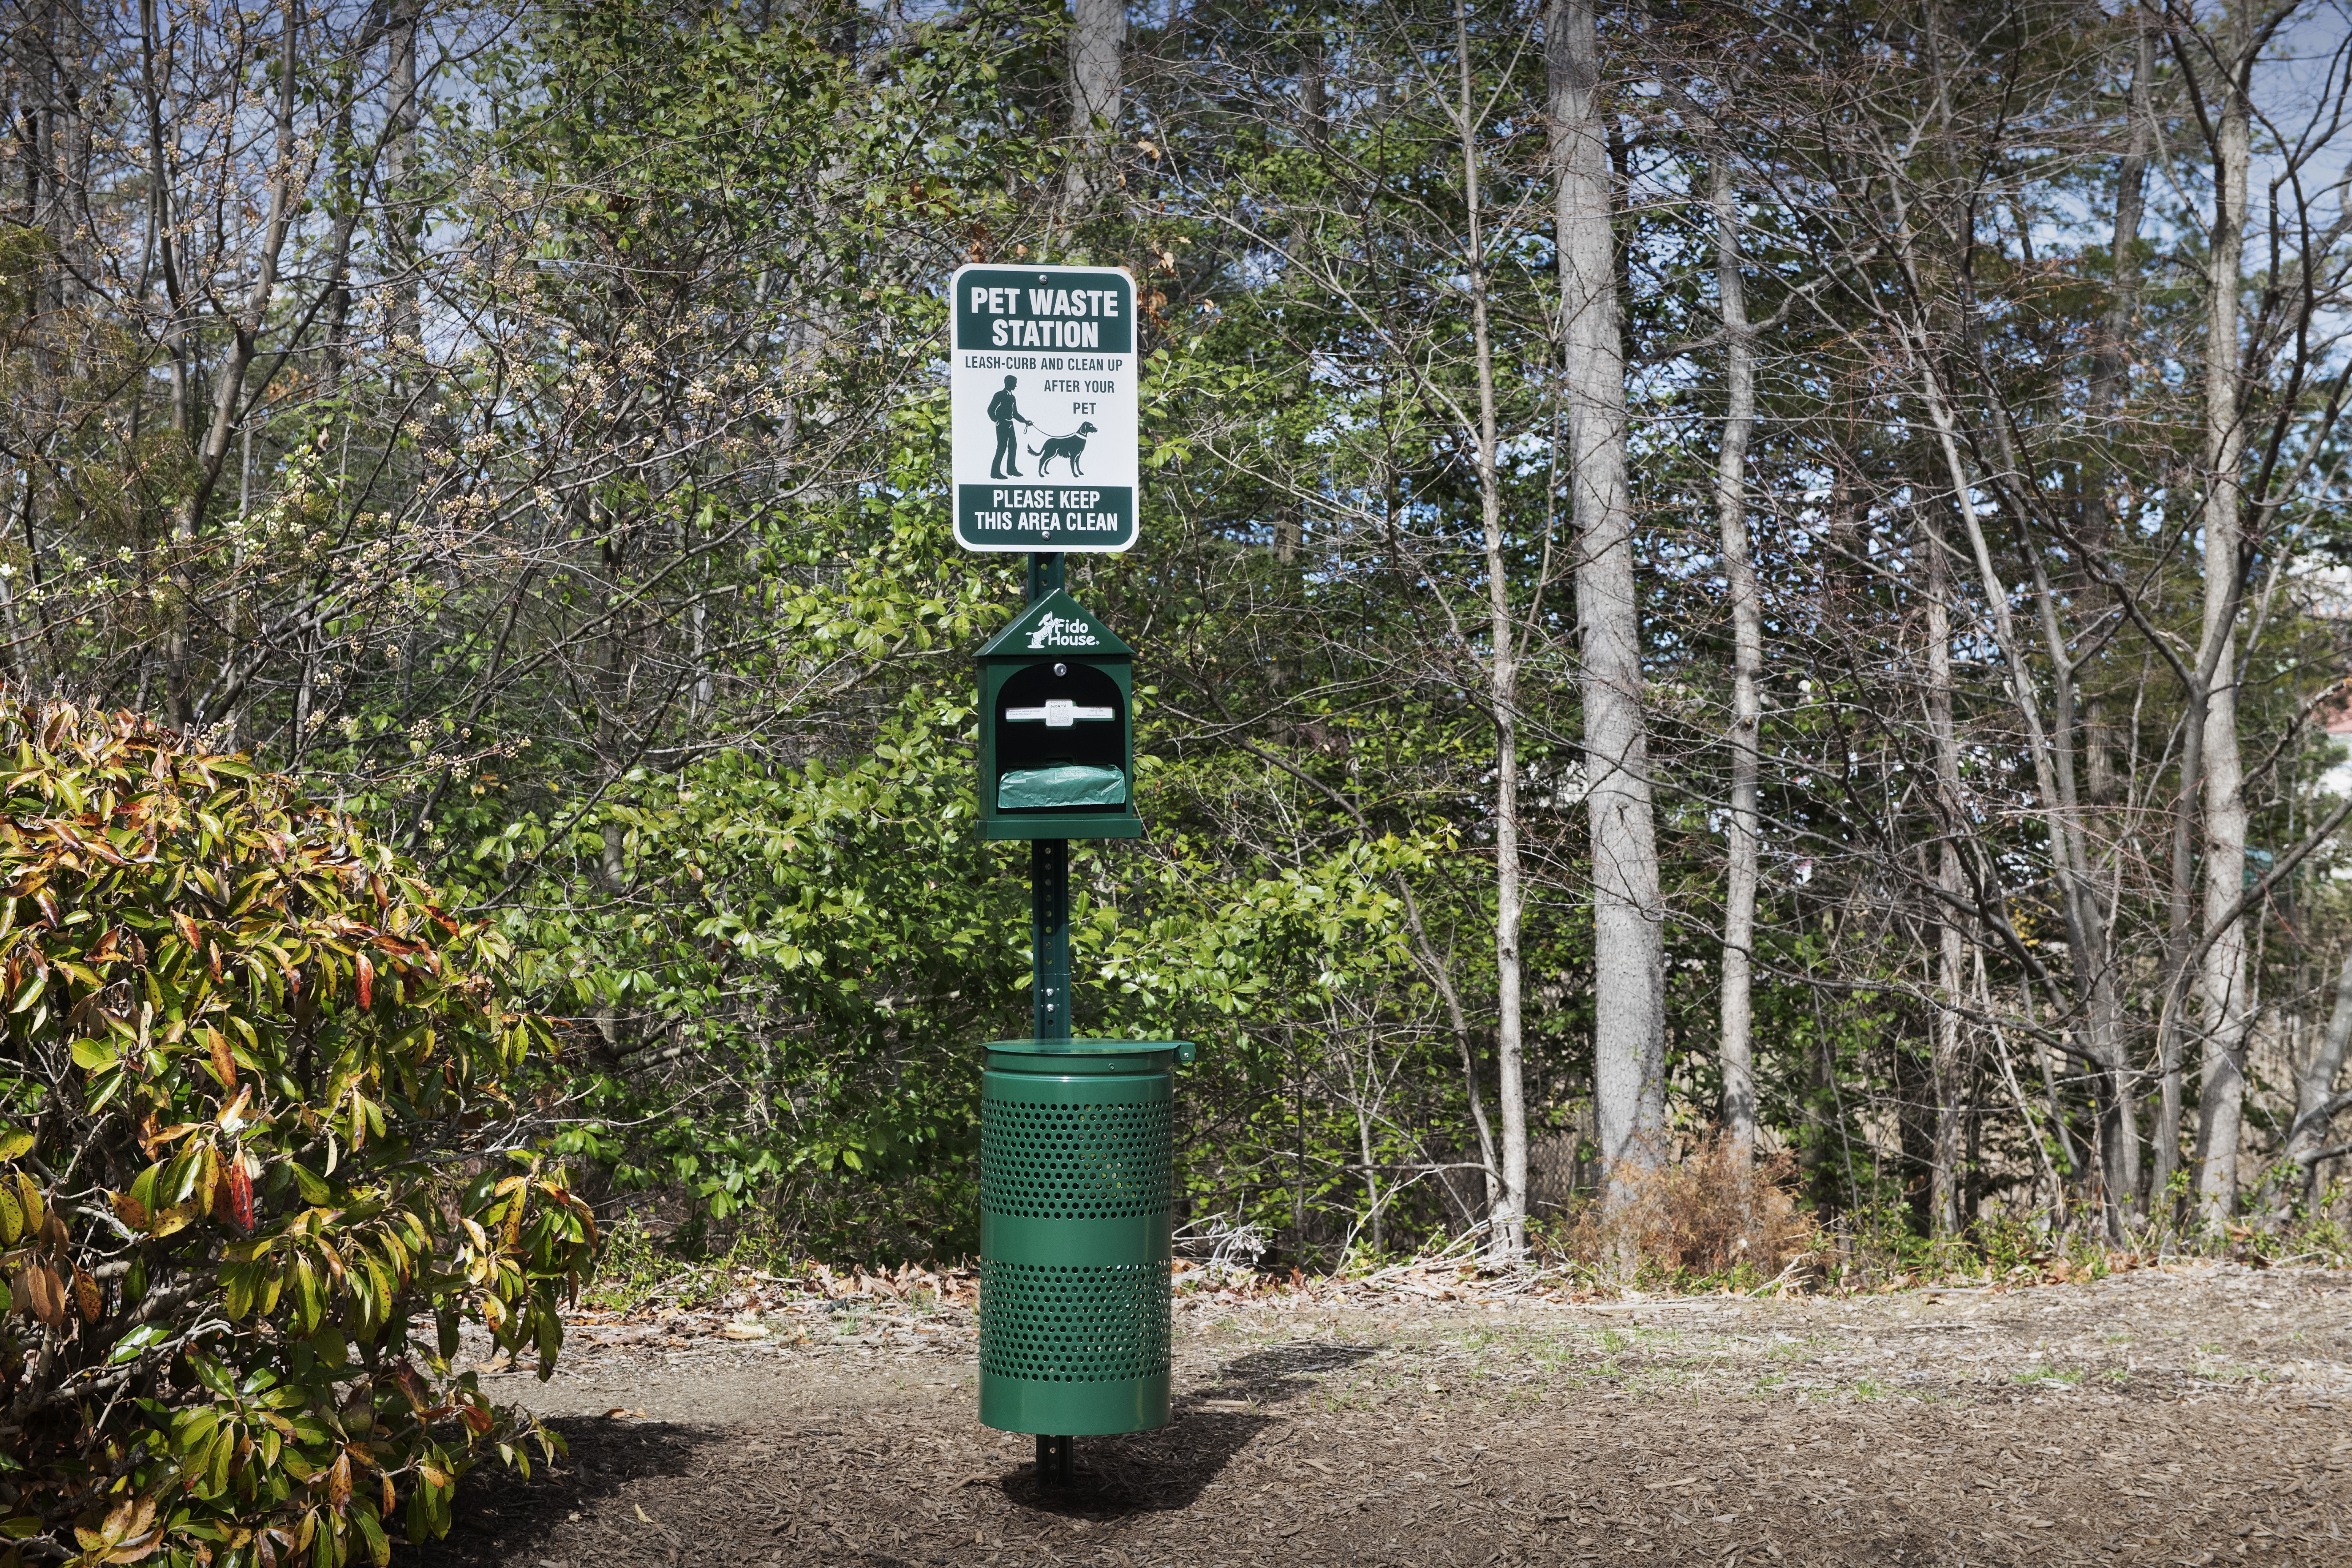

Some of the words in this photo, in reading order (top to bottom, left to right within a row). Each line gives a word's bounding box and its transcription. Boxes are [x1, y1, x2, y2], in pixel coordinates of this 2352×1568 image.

[971, 287, 1020, 314] PET
[1029, 289, 1118, 317] WASTE
[992, 319, 1098, 348] STATION
[965, 356, 1036, 370] LEASH-CURB
[1041, 358, 1063, 370] AND
[1068, 358, 1103, 371] CLEAN
[1108, 359, 1122, 371] UP
[1044, 380, 1080, 392] AFTER
[1084, 380, 1114, 393] YOUR
[1073, 402, 1096, 414] PET
[993, 490, 1054, 509] PLEASE
[1060, 490, 1100, 509] KEEP
[974, 512, 1012, 530] THIS
[1017, 512, 1061, 530] AREA
[1066, 513, 1118, 531] CLEAN
[1055, 618, 1088, 634] Fido
